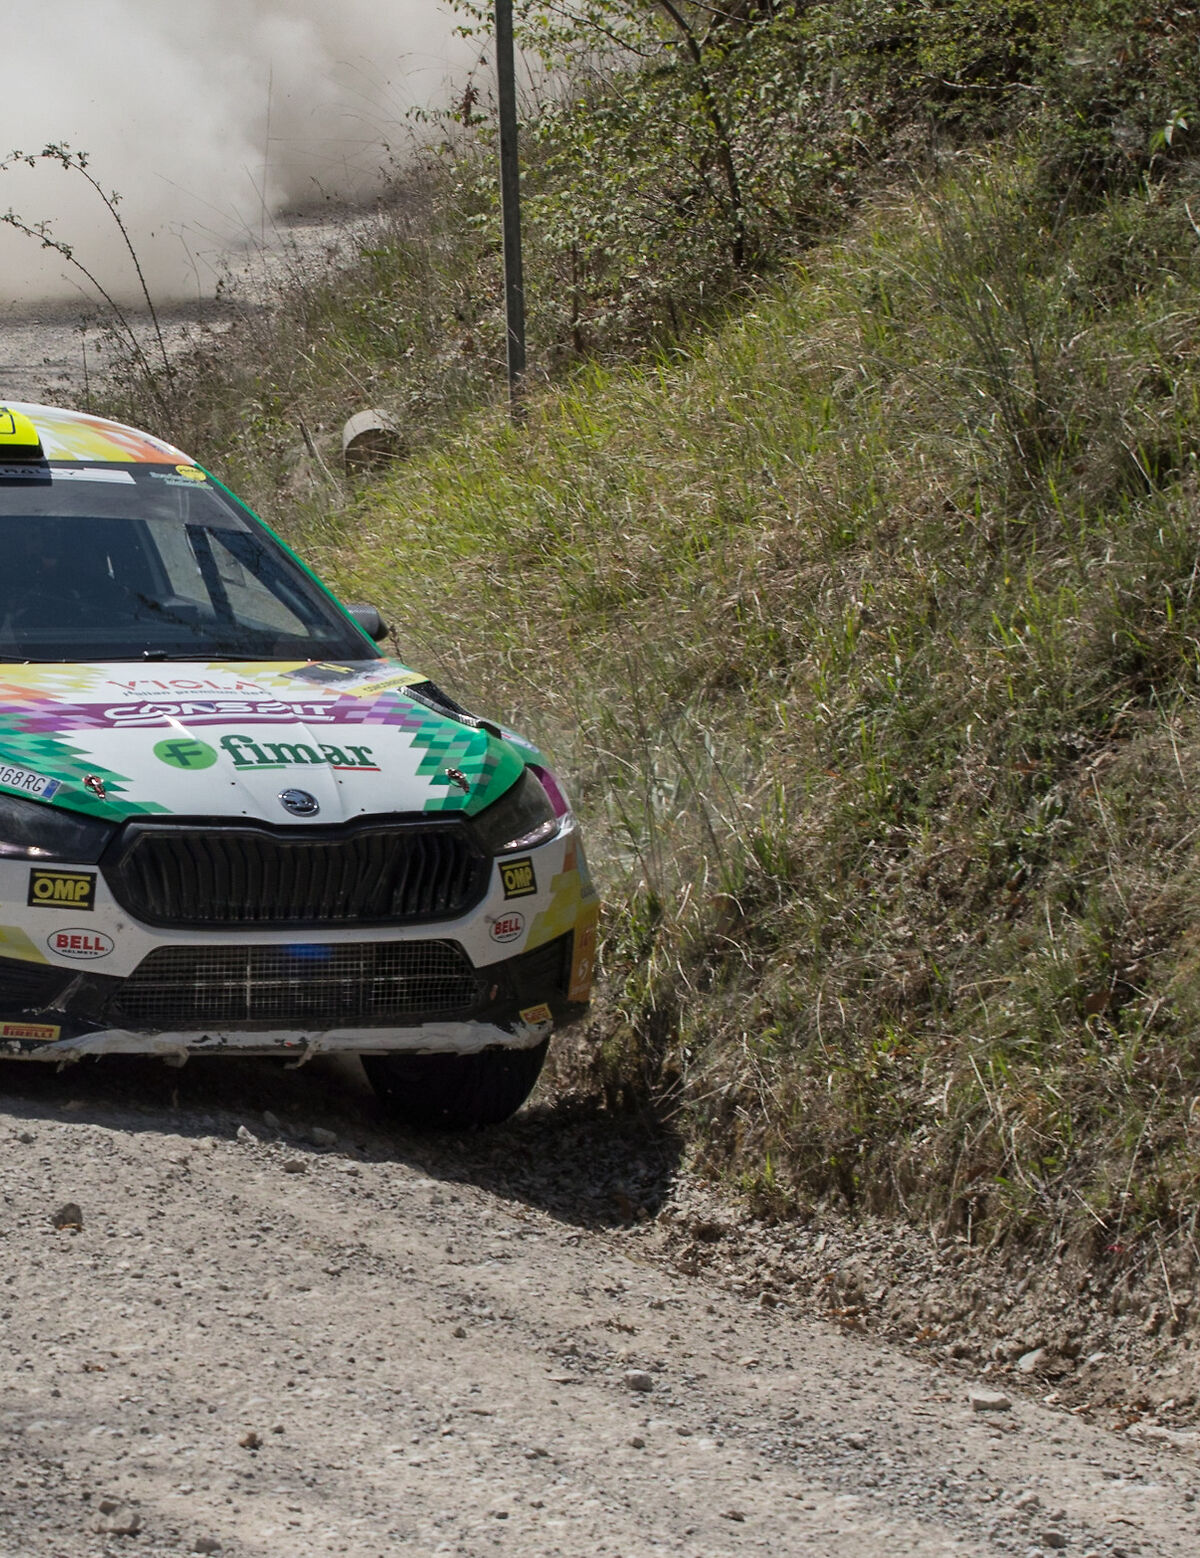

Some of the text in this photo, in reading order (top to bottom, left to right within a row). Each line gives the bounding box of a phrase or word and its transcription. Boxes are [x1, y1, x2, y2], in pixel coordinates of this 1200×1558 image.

[220, 735, 377, 767] fimar
[34, 878, 92, 901] OMP
[504, 867, 533, 890] OMP
[494, 918, 521, 935] BELL
[56, 934, 105, 951] BELL
